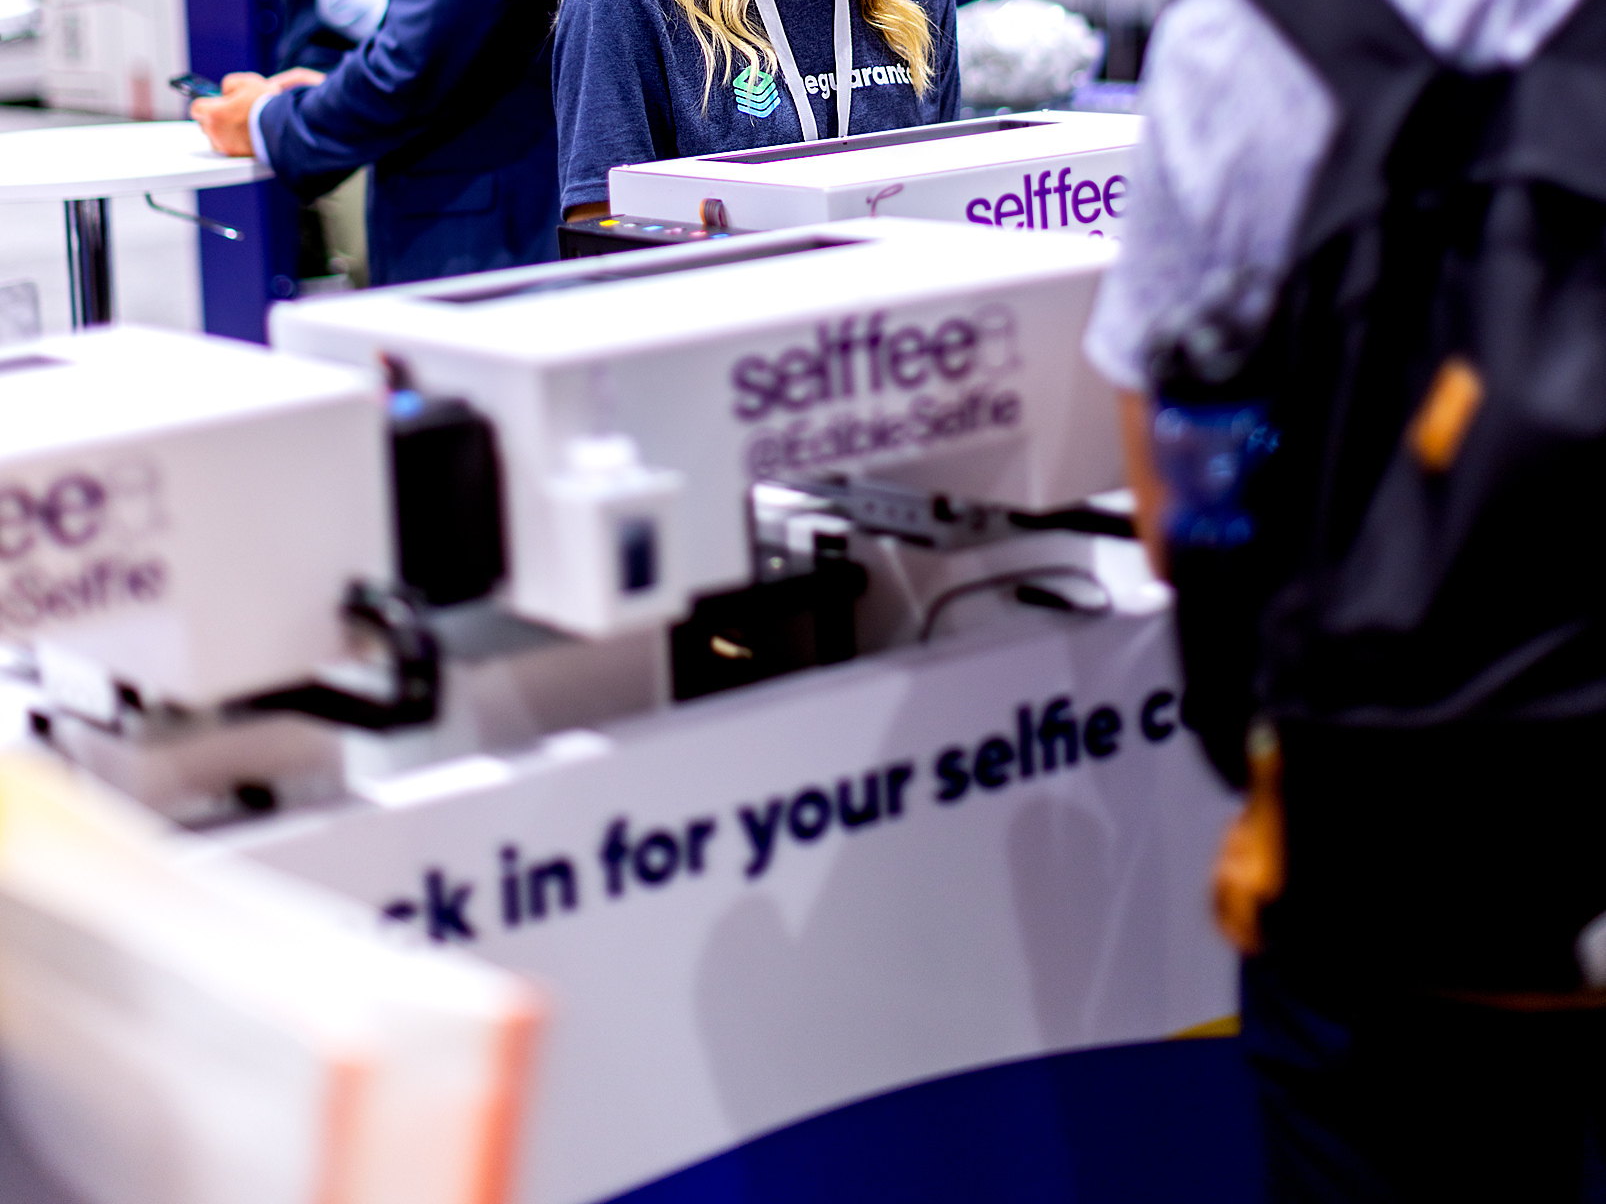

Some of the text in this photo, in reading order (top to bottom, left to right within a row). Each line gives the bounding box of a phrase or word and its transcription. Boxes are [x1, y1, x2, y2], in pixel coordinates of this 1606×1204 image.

[965, 166, 1131, 232] selffee
[381, 867, 477, 944] k
[500, 843, 579, 927] in
[602, 815, 716, 900] for
[738, 759, 913, 880] your
[934, 696, 1122, 803] selfie
